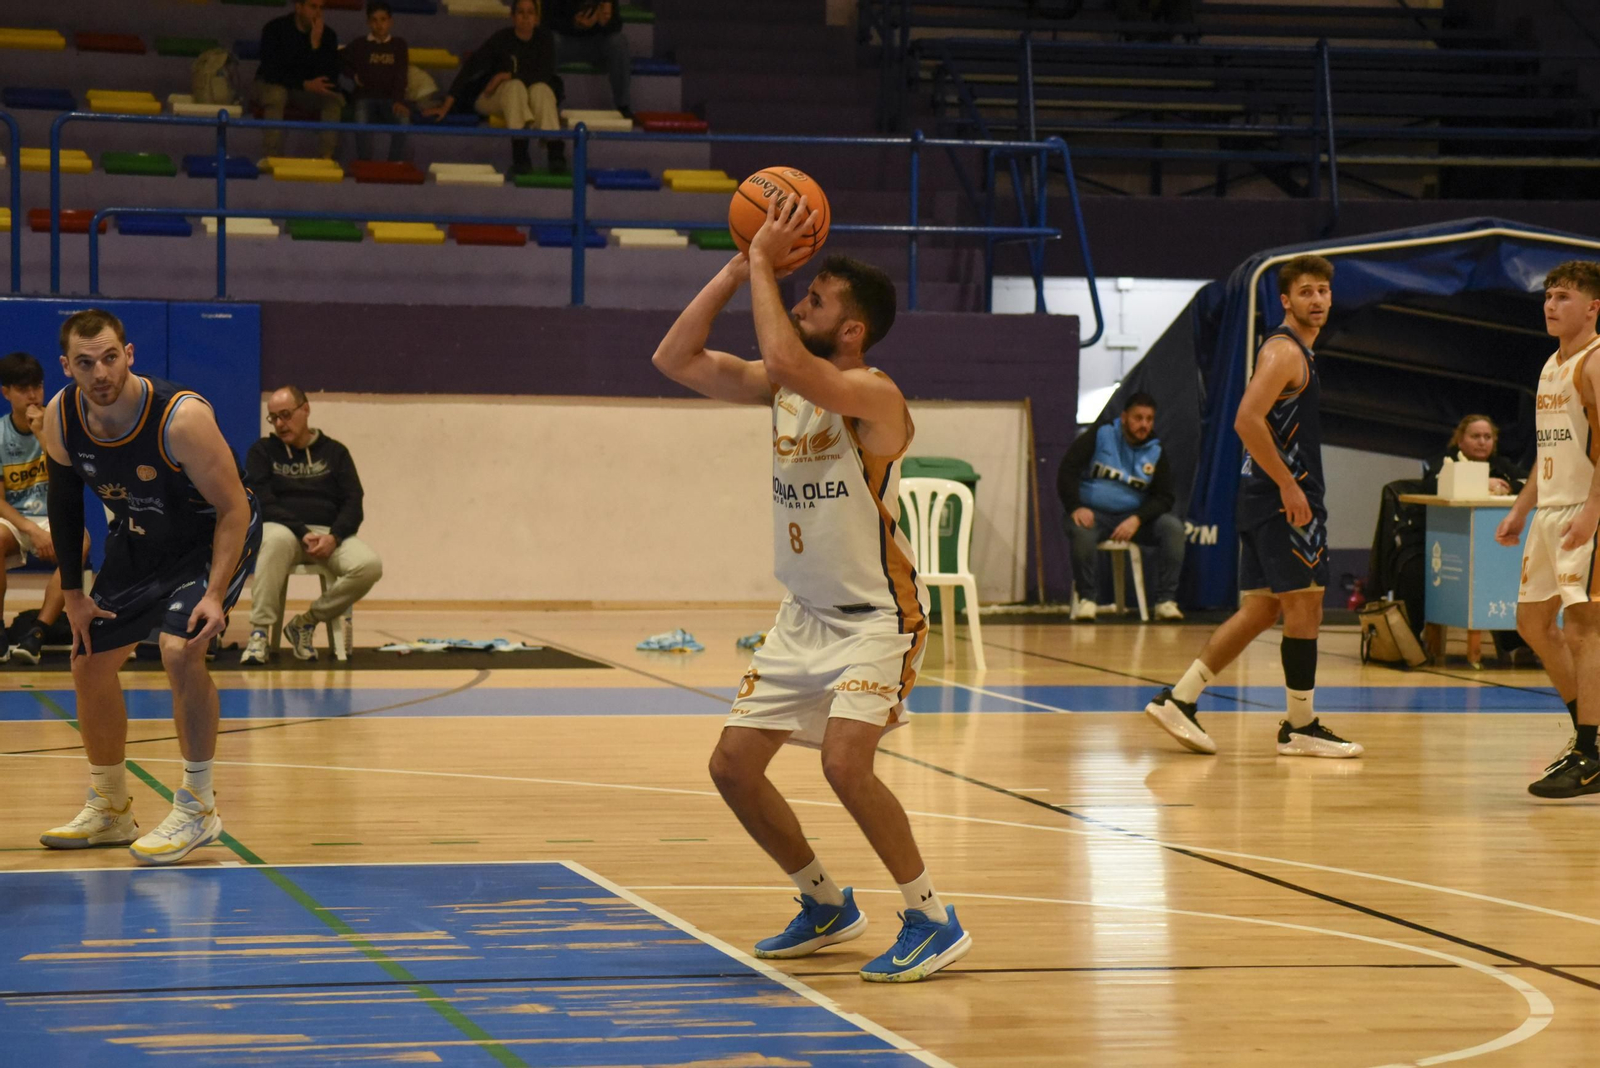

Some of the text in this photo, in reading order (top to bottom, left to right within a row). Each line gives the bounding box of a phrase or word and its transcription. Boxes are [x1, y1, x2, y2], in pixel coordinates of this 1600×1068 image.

[814, 453, 844, 463] MOTRIL
[803, 480, 849, 500] OLEA
[788, 521, 804, 554] 8
